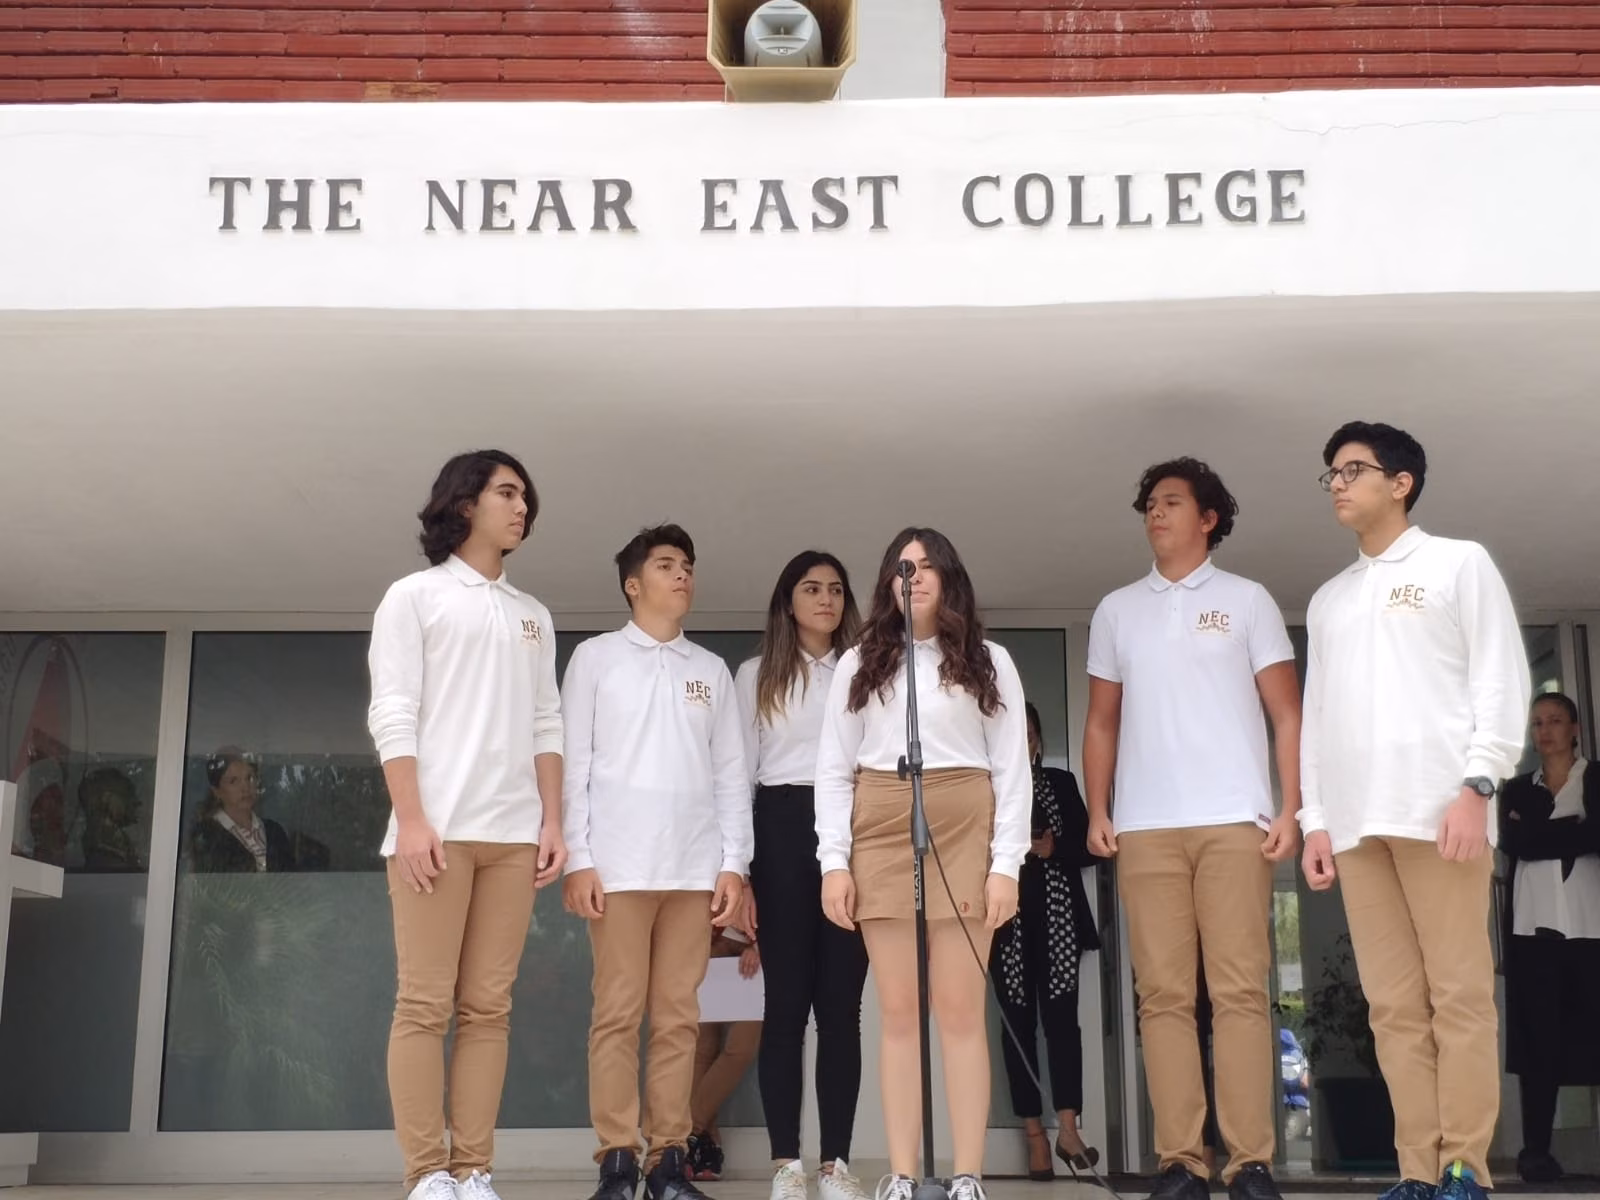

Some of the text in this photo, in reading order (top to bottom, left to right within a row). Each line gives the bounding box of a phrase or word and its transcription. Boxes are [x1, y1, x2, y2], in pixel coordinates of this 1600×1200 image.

[209, 168, 1306, 232] THE NEAR EAST COLLEGE
[1390, 584, 1425, 602] NEC
[1198, 610, 1230, 626] NEC
[685, 680, 711, 699] NEC
